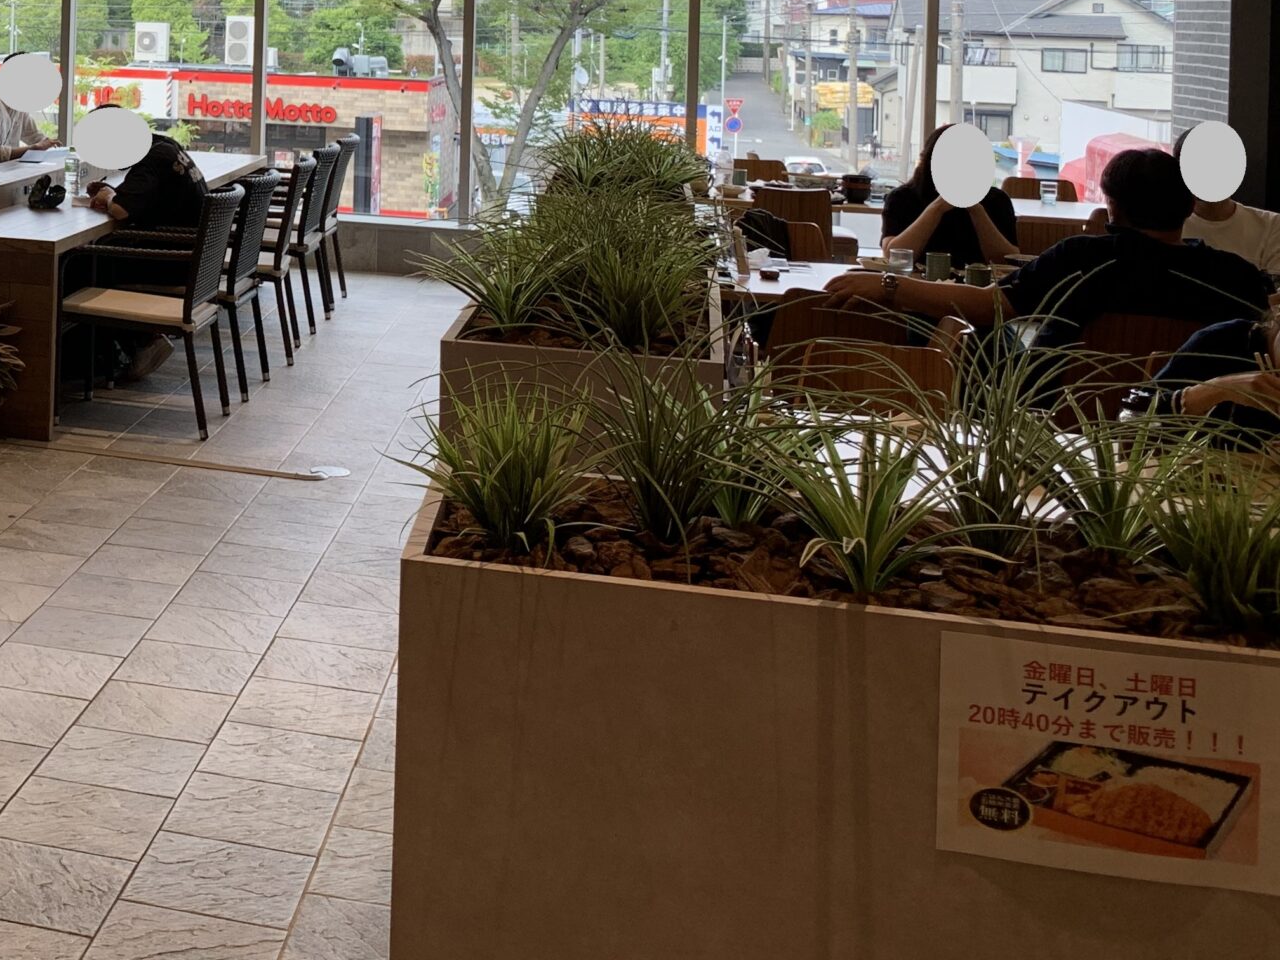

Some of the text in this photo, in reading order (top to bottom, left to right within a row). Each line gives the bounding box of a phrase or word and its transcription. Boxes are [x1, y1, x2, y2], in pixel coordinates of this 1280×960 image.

[187, 93, 337, 124] Hotto Motto
[1022, 660, 1197, 698] 金曜日、土曜日
[1021, 683, 1197, 723] テイクアウト
[968, 704, 1245, 756] 20時40分まで販売！！！
